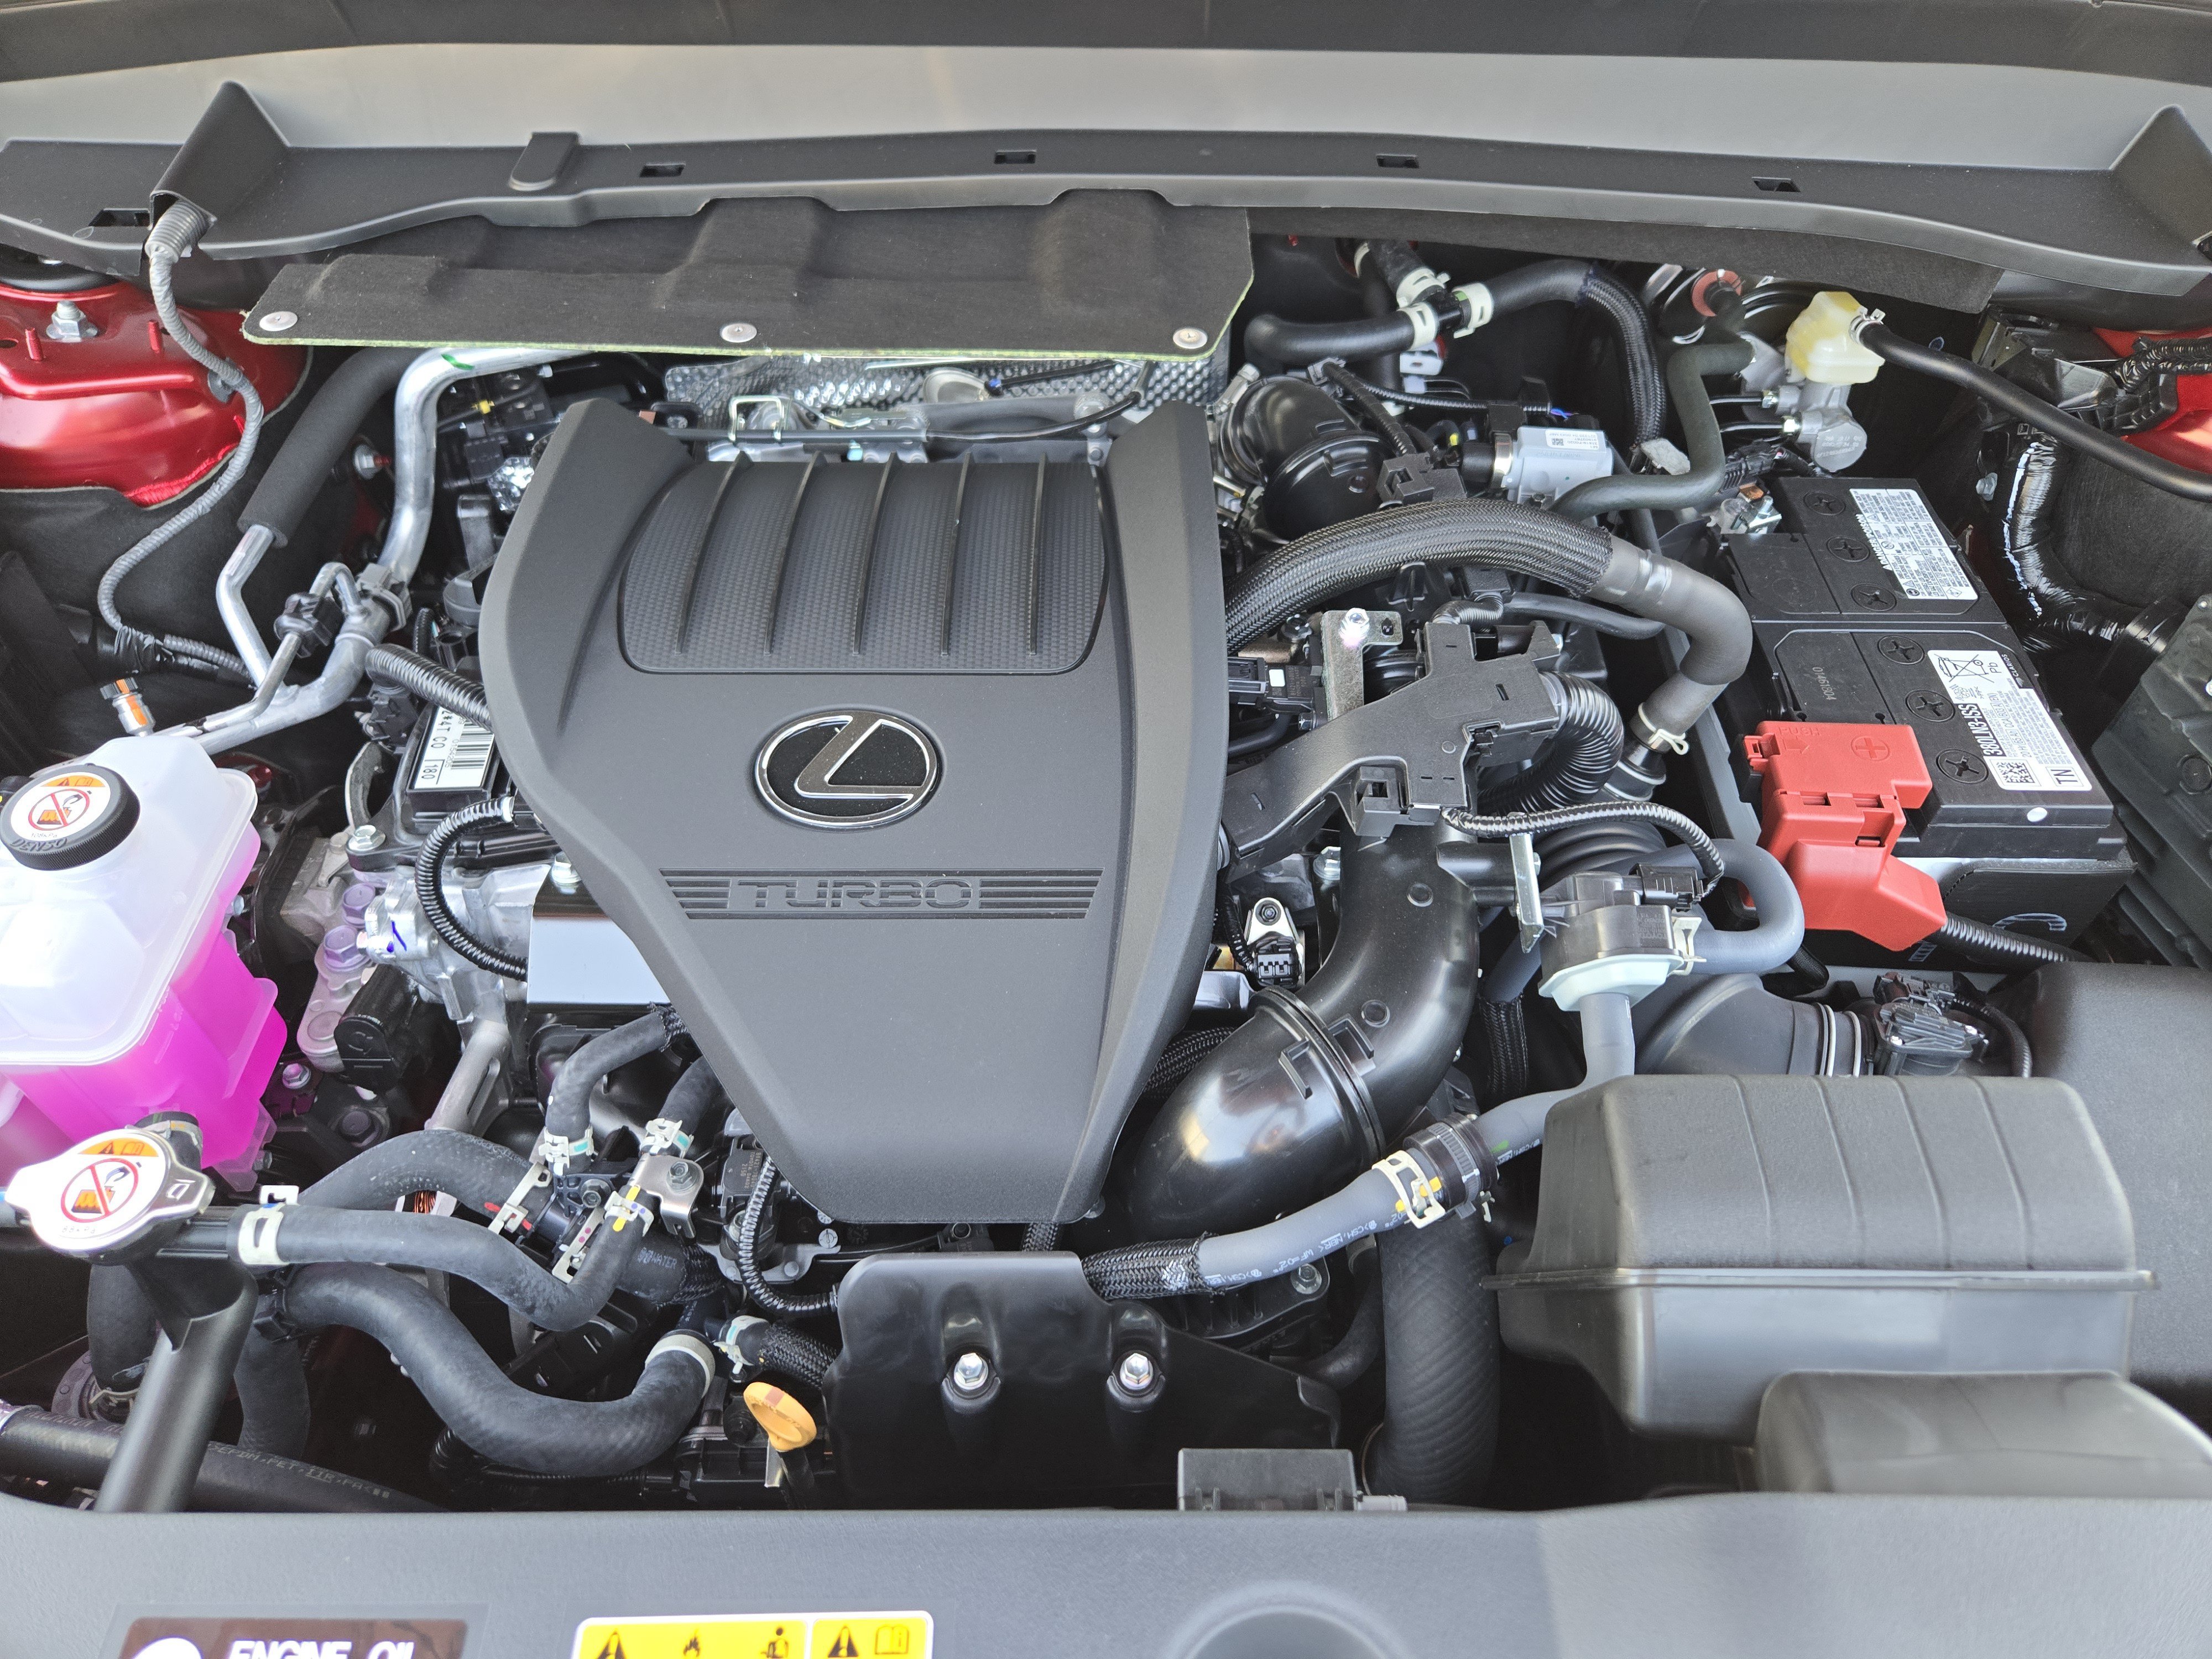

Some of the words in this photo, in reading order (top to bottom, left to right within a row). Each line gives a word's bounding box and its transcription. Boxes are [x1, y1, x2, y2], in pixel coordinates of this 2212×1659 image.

[1985, 662, 2002, 673] Pb
[2001, 654, 2020, 676] CLARIOS
[1957, 704, 2004, 755] 380LN3-ISS
[2000, 718, 2015, 727] CCA
[1778, 727, 1822, 735] PUSH
[431, 736, 447, 749] CO
[421, 764, 439, 779] 180
[2049, 769, 2080, 784] TN
[10, 838, 67, 852] DENSO
[738, 879, 972, 908] TURBO
[651, 1252, 677, 1270] WATER
